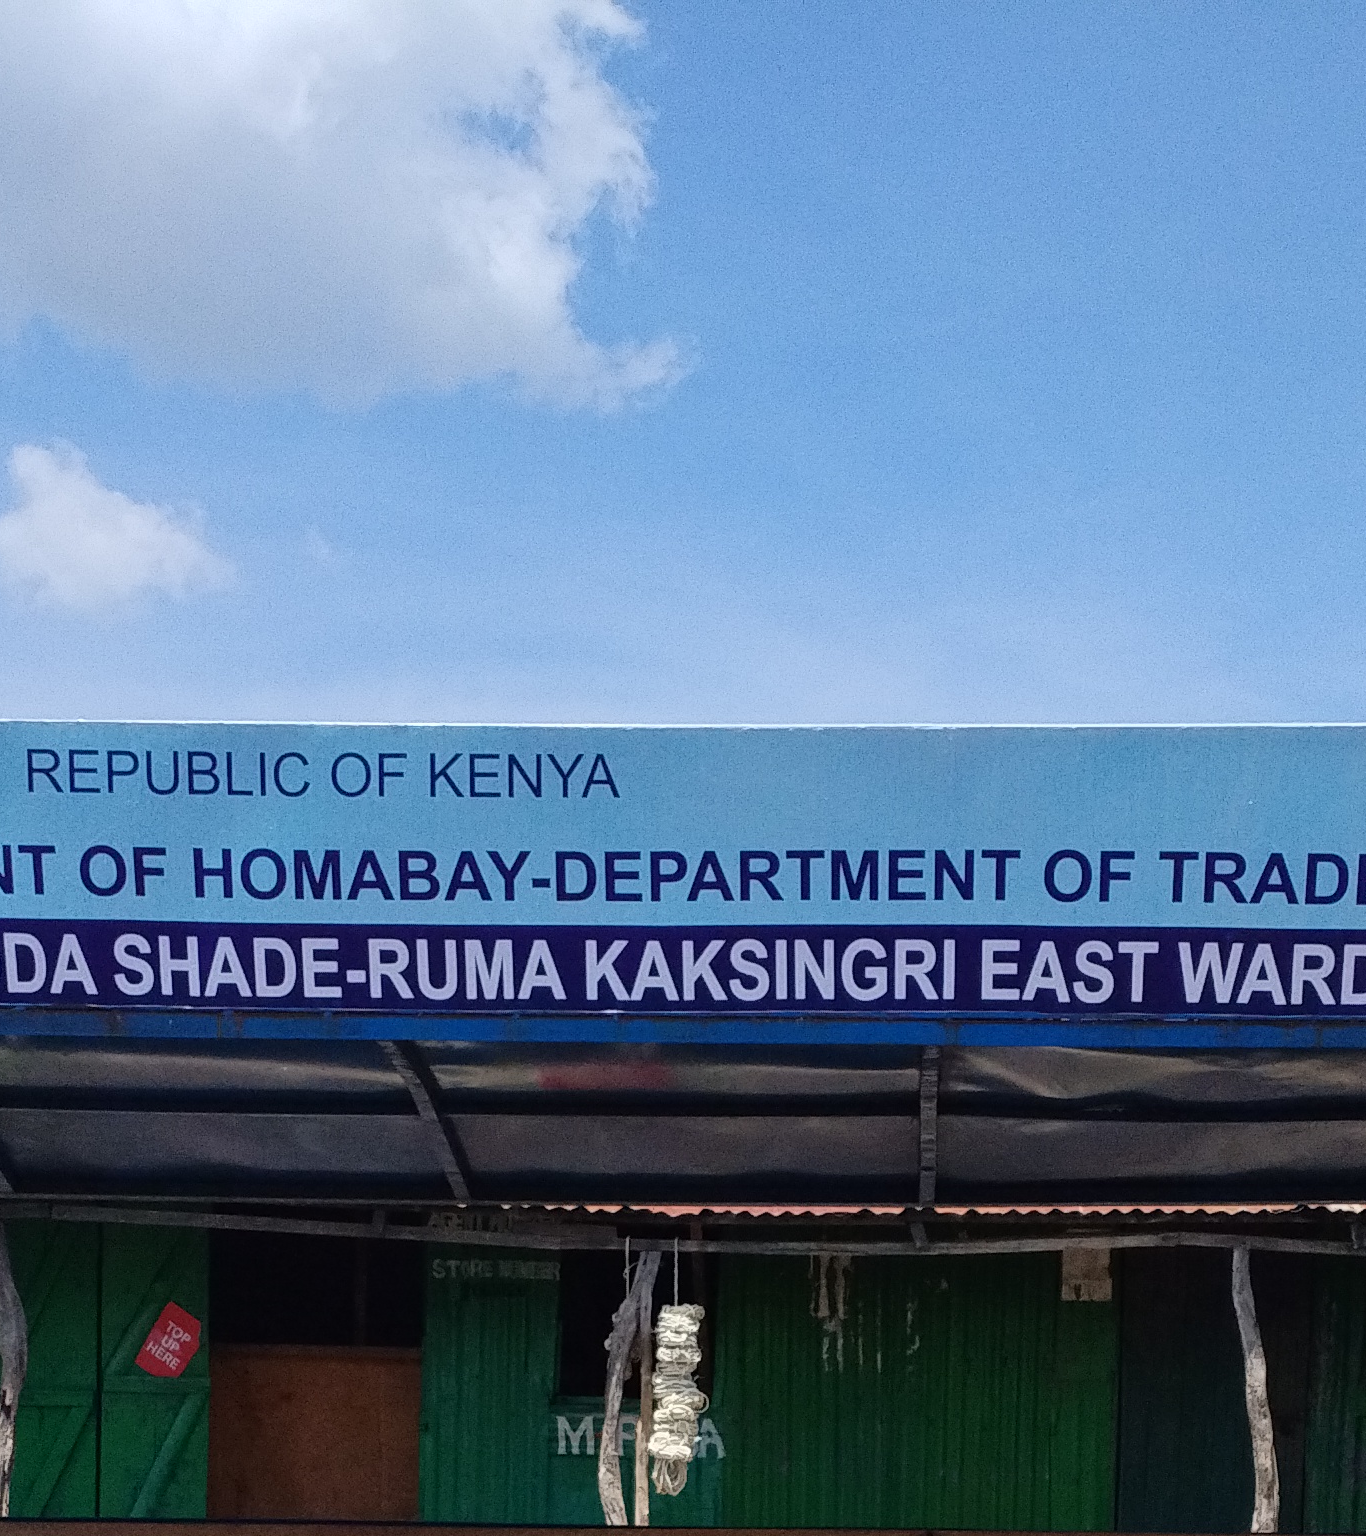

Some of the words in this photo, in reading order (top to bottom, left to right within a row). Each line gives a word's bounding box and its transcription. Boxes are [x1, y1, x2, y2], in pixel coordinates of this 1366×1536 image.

[26, 748, 310, 797] REPUBLIC
[332, 752, 408, 798] OF
[429, 753, 621, 799] KENYA
[78, 845, 167, 899] OF
[193, 847, 1021, 903] HOMABAY-DEPARTMENT
[1043, 849, 1136, 904] OF
[112, 931, 568, 1001] SHADE-RUMA
[583, 937, 957, 1003] KAKSINGRI
[980, 939, 1160, 1005] EAST
[161, 1334, 180, 1352] UP
[166, 1320, 192, 1343] TOP
[146, 1341, 181, 1371] HERE
